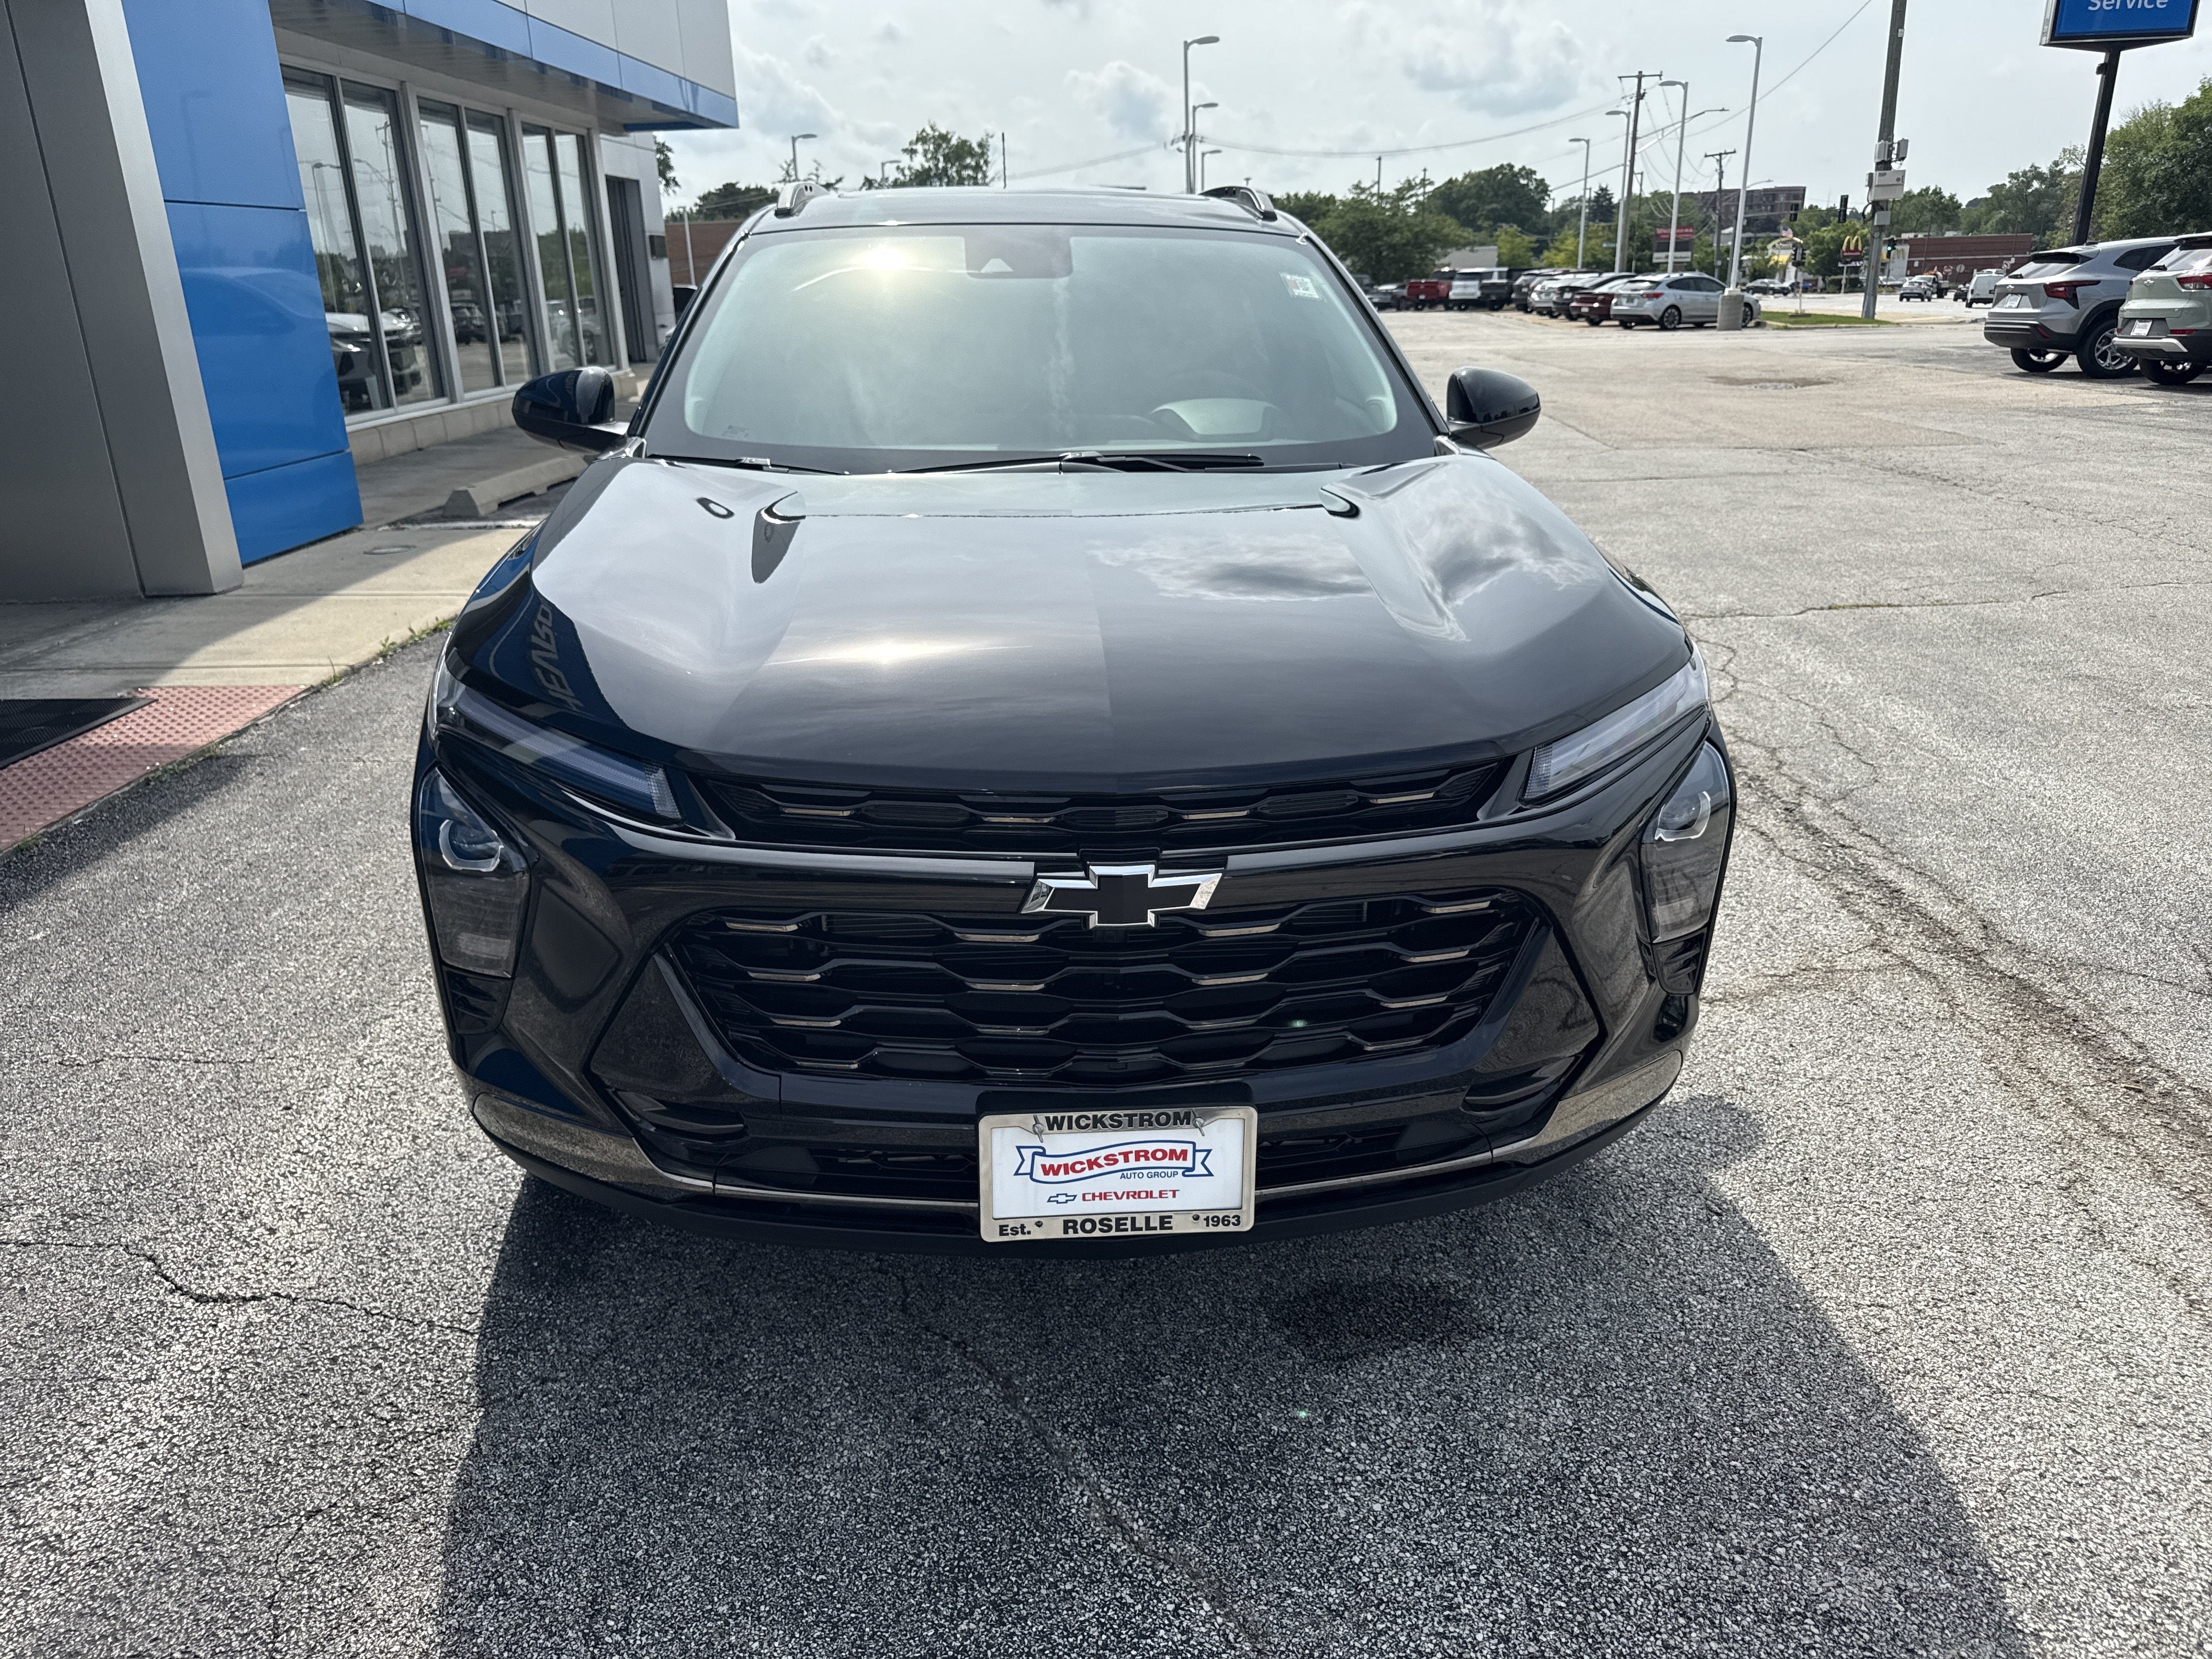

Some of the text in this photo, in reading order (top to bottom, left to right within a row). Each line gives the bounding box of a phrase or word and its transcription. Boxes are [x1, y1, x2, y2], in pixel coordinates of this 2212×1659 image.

[2088, 0, 2169, 10] Service
[1045, 1110, 1192, 1131] WICKSTROM
[1040, 1148, 1188, 1176] WICKSTROM
[1120, 1170, 1179, 1180] AUTO GROUP
[1082, 1189, 1180, 1201] CHEVROLET
[998, 1215, 1241, 1237] Est. ROSELLE 1963
